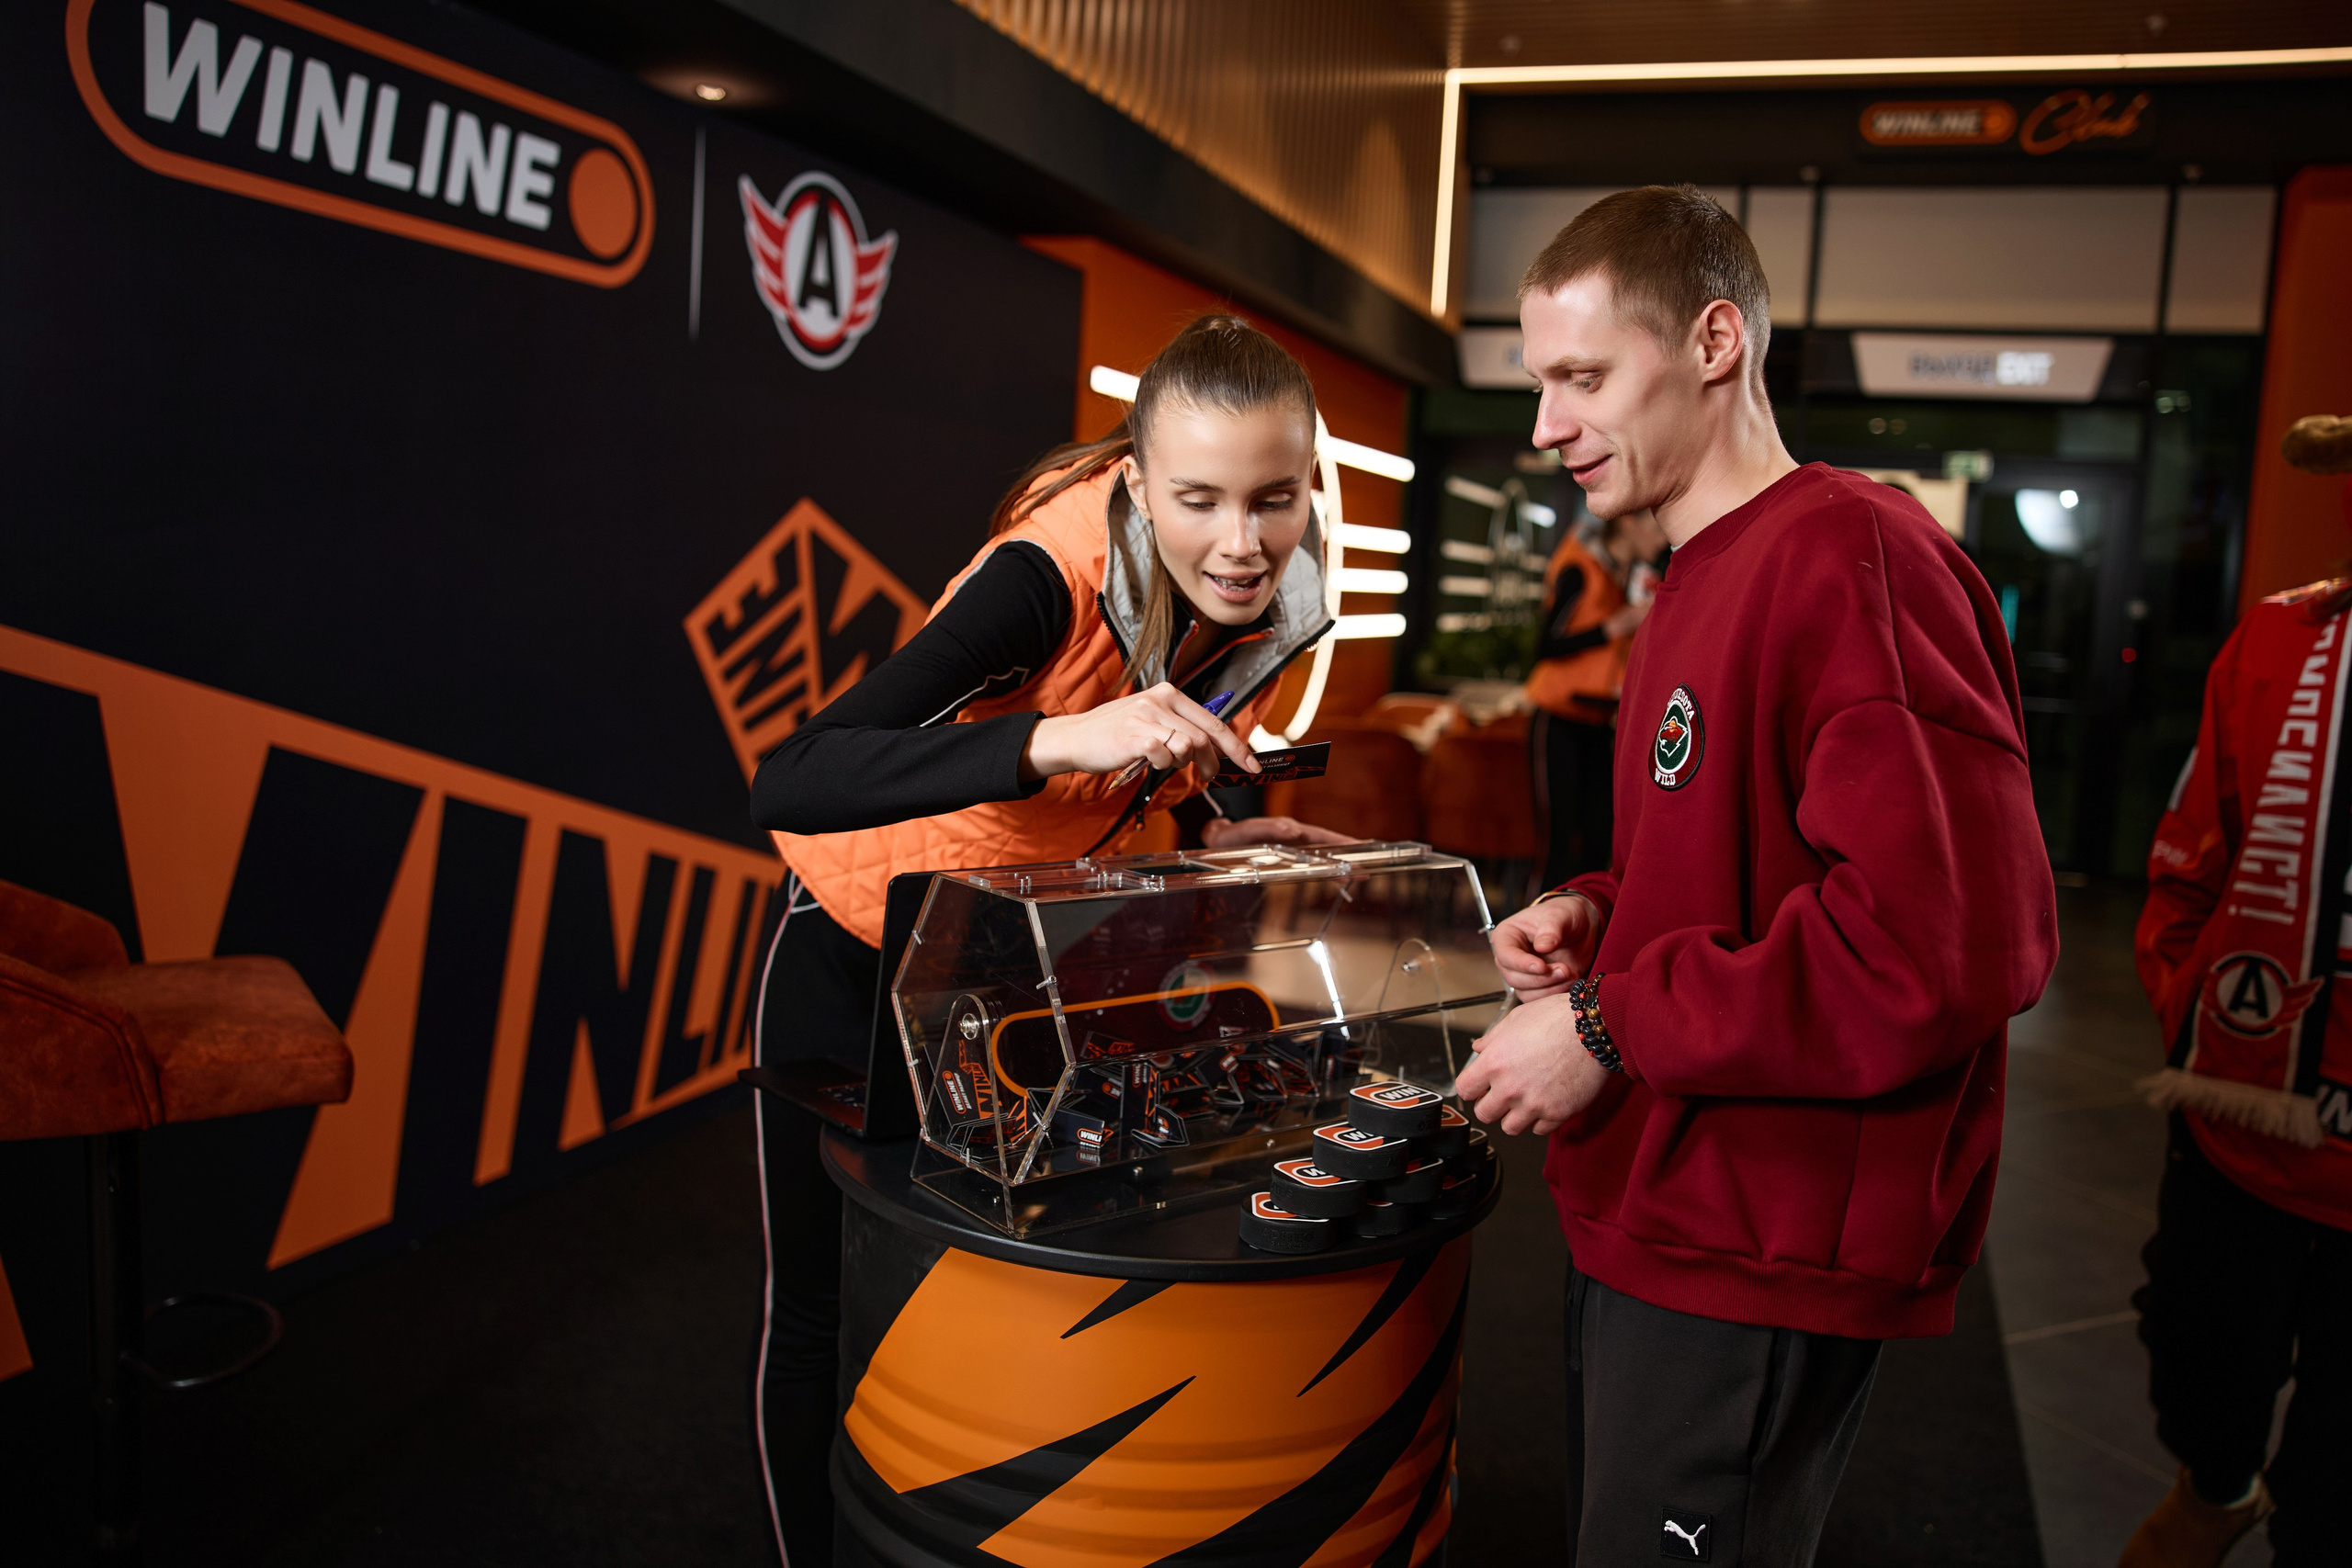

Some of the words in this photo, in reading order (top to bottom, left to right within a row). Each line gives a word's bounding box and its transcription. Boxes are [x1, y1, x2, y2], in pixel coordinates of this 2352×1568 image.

[143, 1, 560, 231] WINLINE
[1259, 756, 1284, 765] NLINE
[1655, 768, 1676, 786] WILD
[946, 1079, 965, 1111] WINLINE
[1379, 1087, 1421, 1100] WIN
[1080, 1130, 1102, 1143] WINLI
